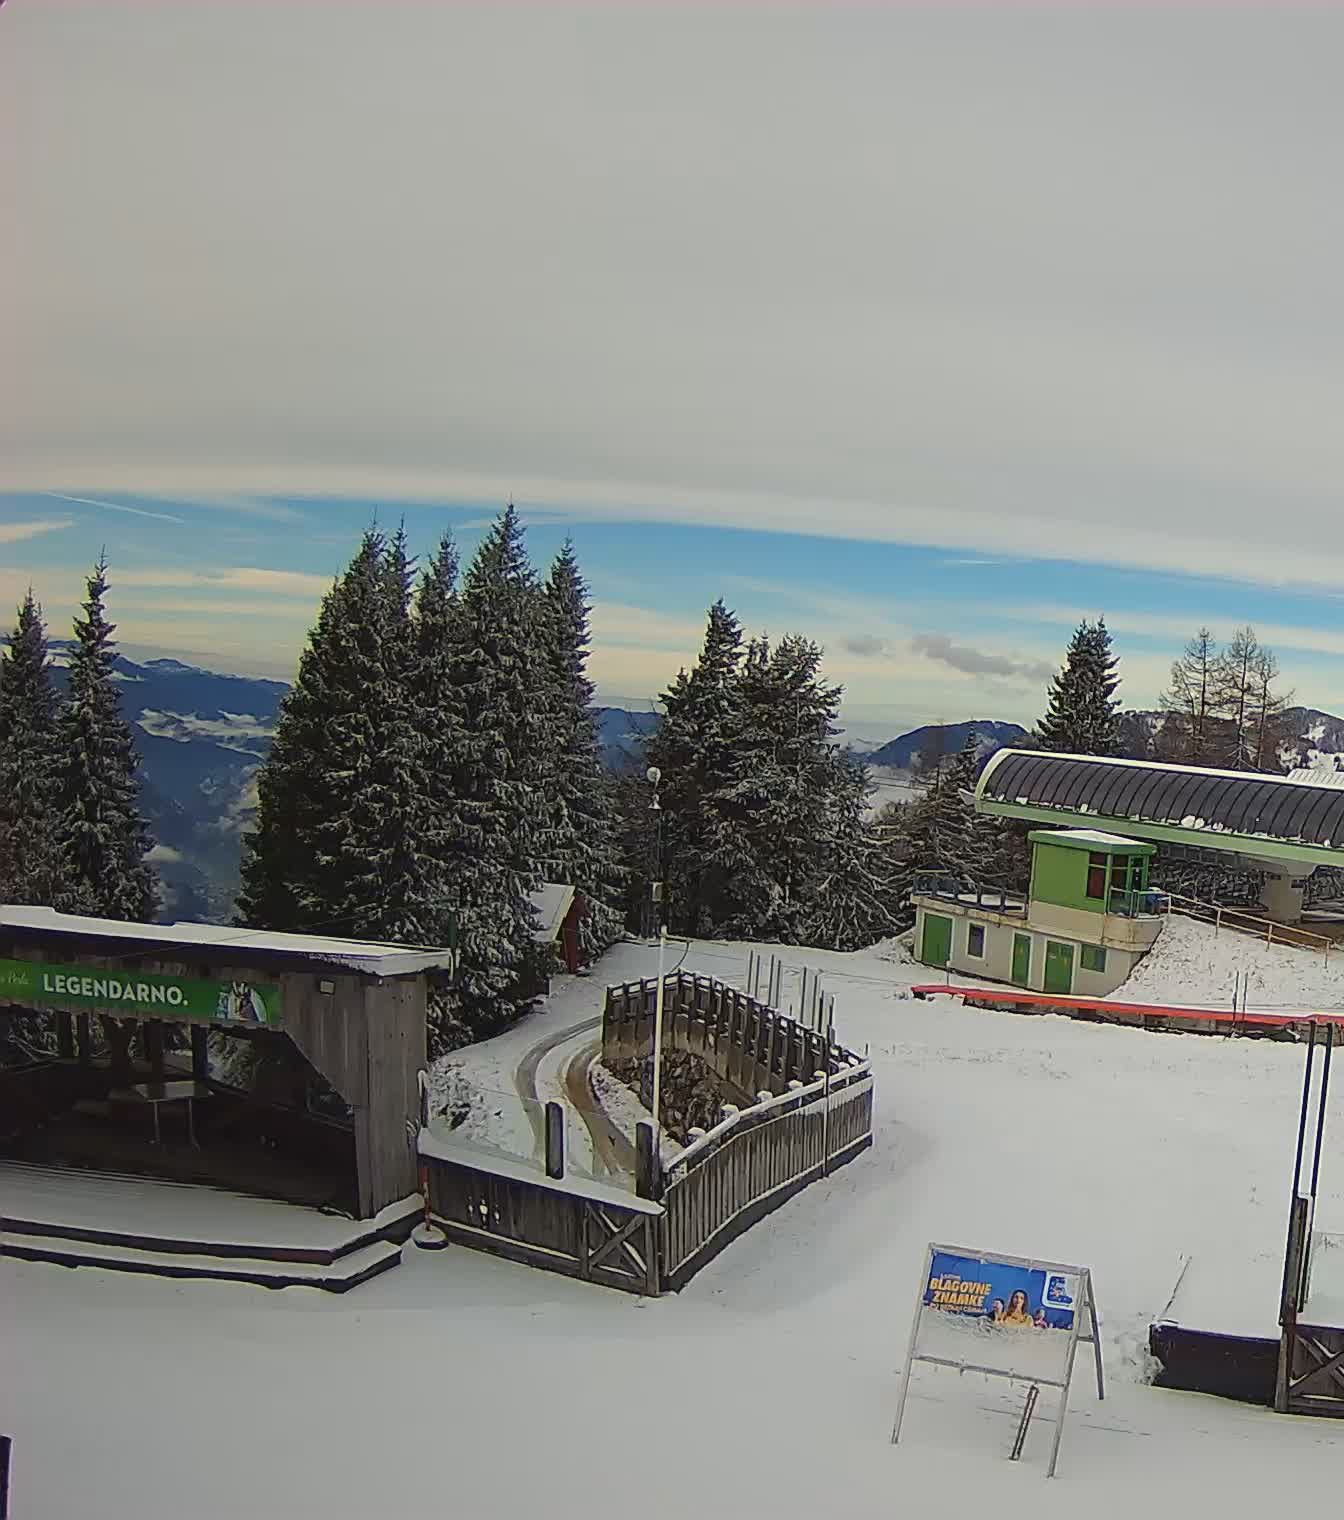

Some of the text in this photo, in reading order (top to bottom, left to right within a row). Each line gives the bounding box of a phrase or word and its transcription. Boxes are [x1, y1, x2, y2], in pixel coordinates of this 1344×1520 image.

[43, 973, 189, 1006] LEGENDARNO.
[930, 1277, 992, 1296] BLAGOVNE
[932, 1290, 985, 1307] ZNAMKE
